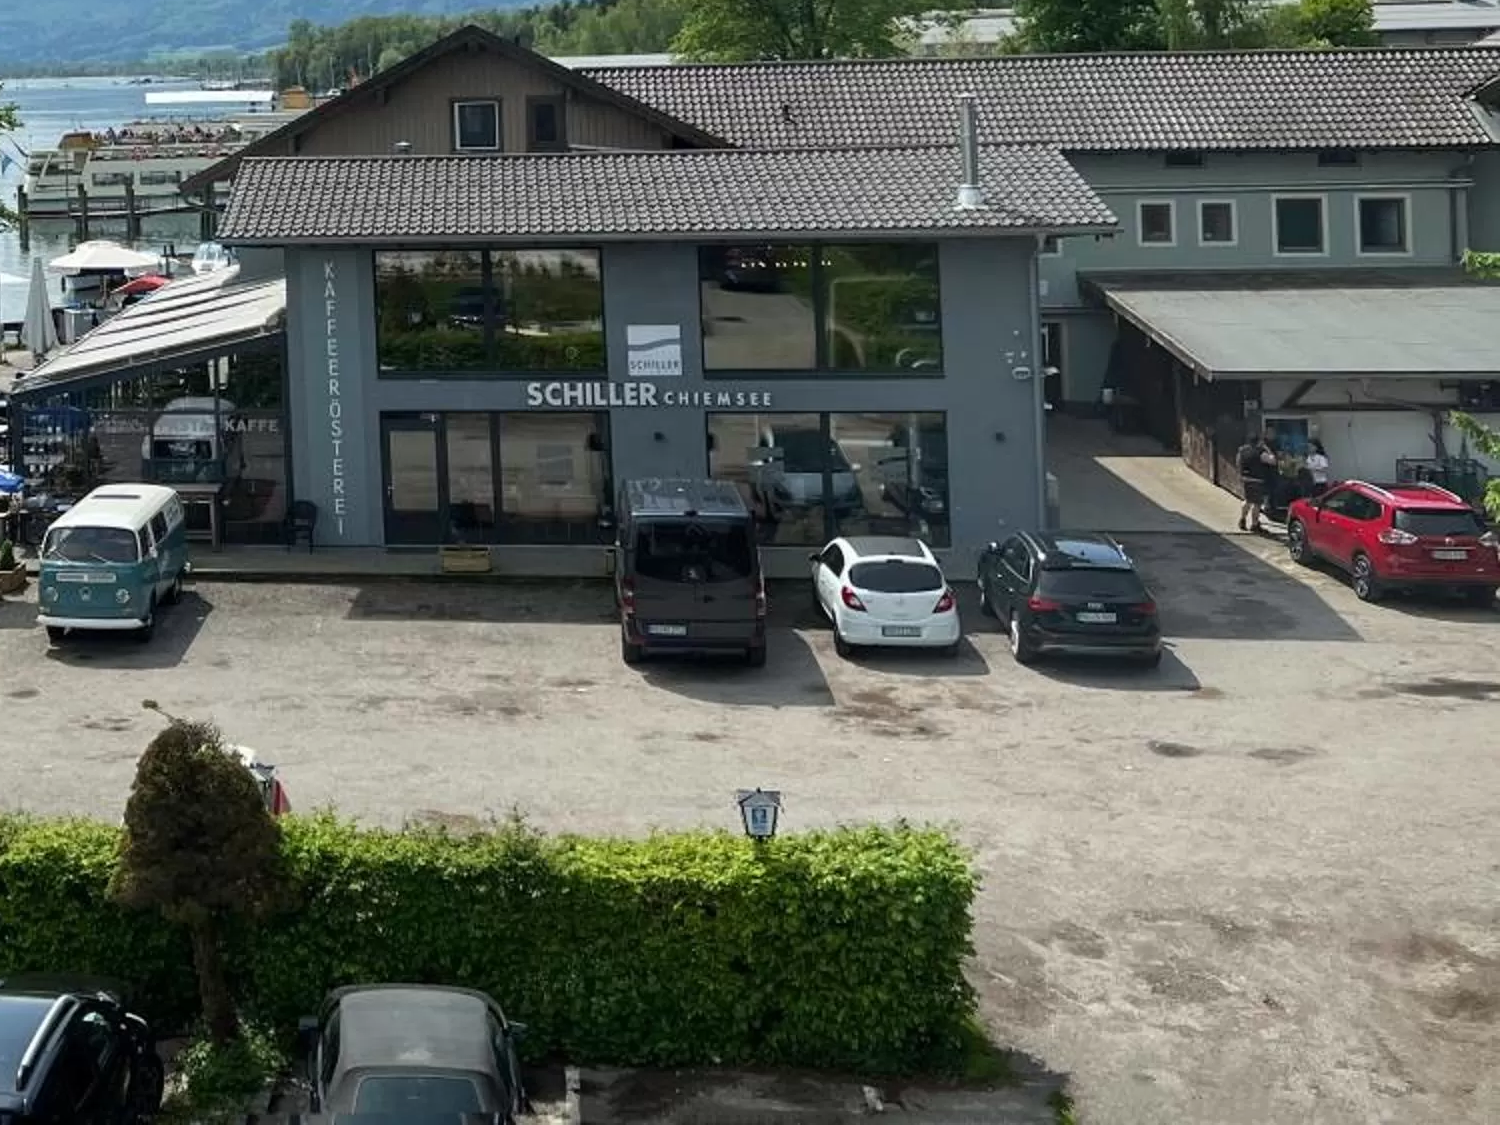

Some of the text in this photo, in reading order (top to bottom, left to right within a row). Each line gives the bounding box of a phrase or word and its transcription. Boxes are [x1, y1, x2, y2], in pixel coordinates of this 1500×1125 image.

[630, 360, 679, 370] SCHILLER
[323, 262, 345, 535] KAFFEERÖSTEREI
[527, 382, 772, 406] SCHILLER CHIEMSEE
[224, 418, 279, 432] KAFFE
